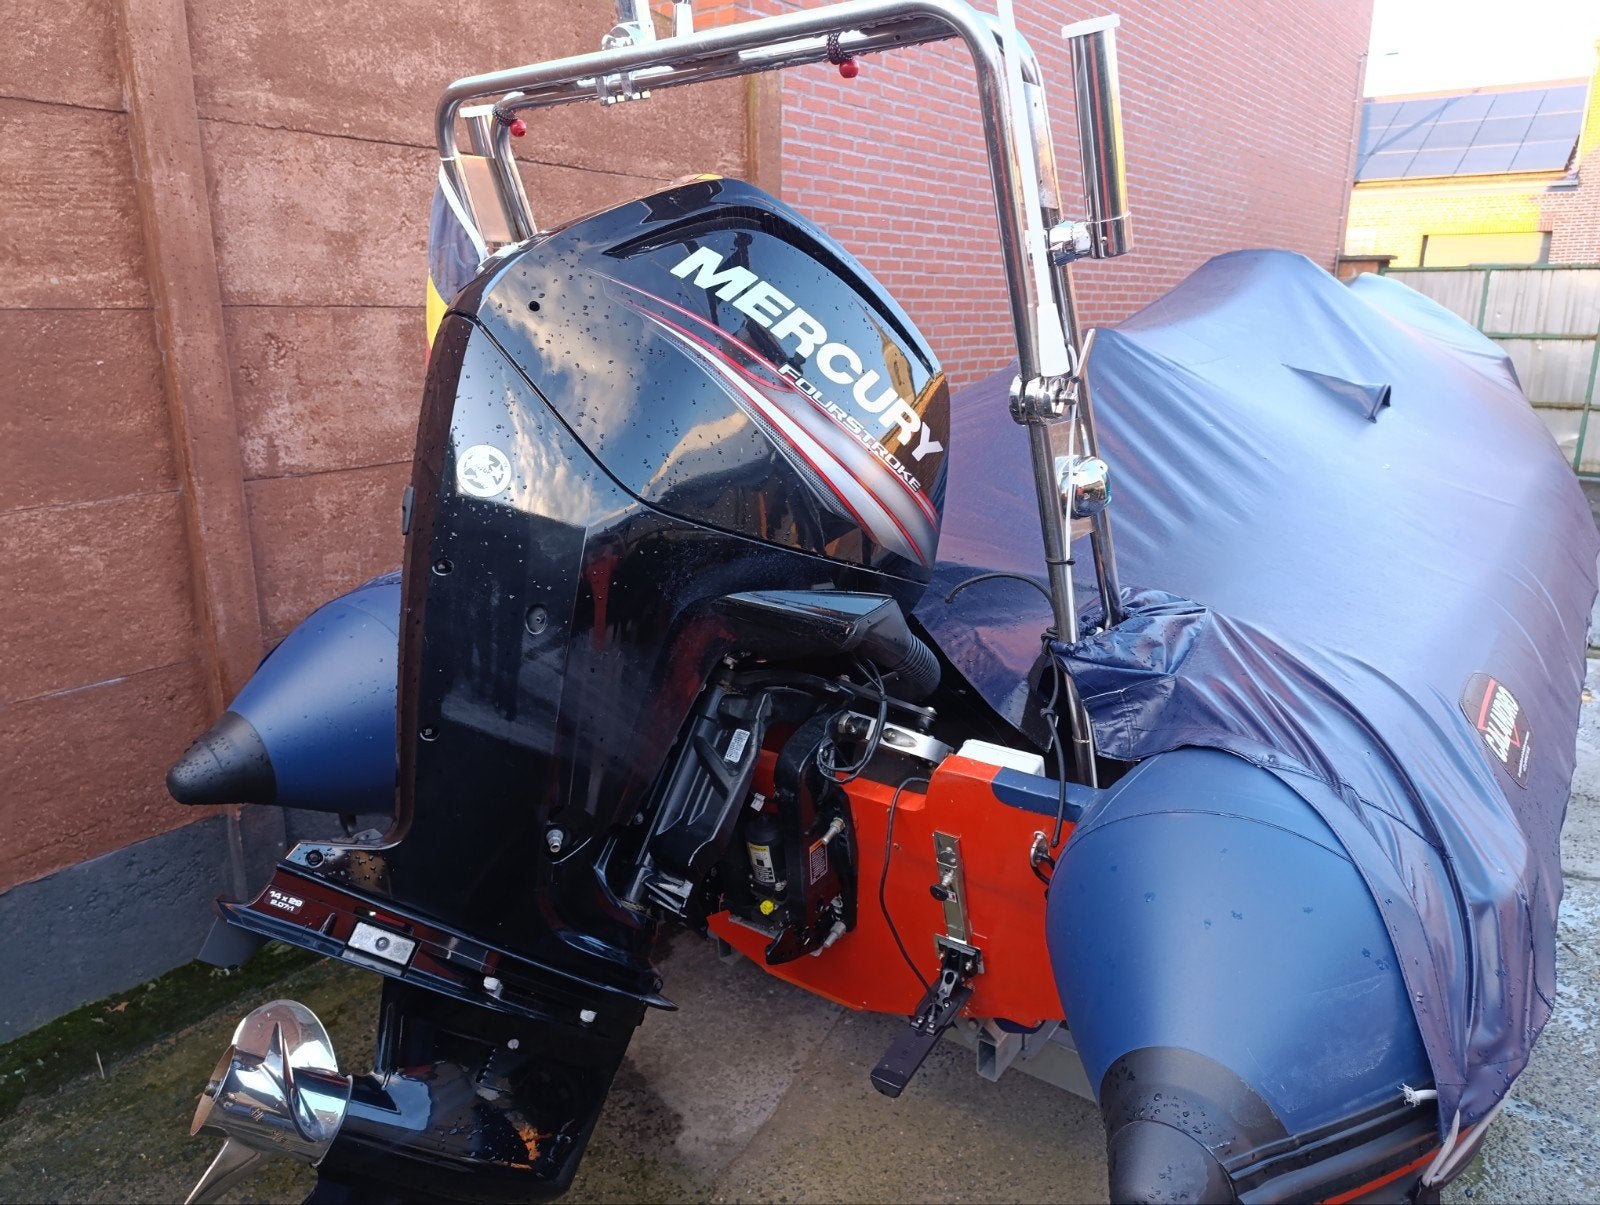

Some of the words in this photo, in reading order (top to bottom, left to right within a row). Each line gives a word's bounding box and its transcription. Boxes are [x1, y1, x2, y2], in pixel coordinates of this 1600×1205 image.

[669, 246, 944, 462] MERCURY
[777, 363, 922, 493] FOURSTROKE
[1485, 685, 1519, 763] CALANDRO
[270, 890, 281, 900] 14
